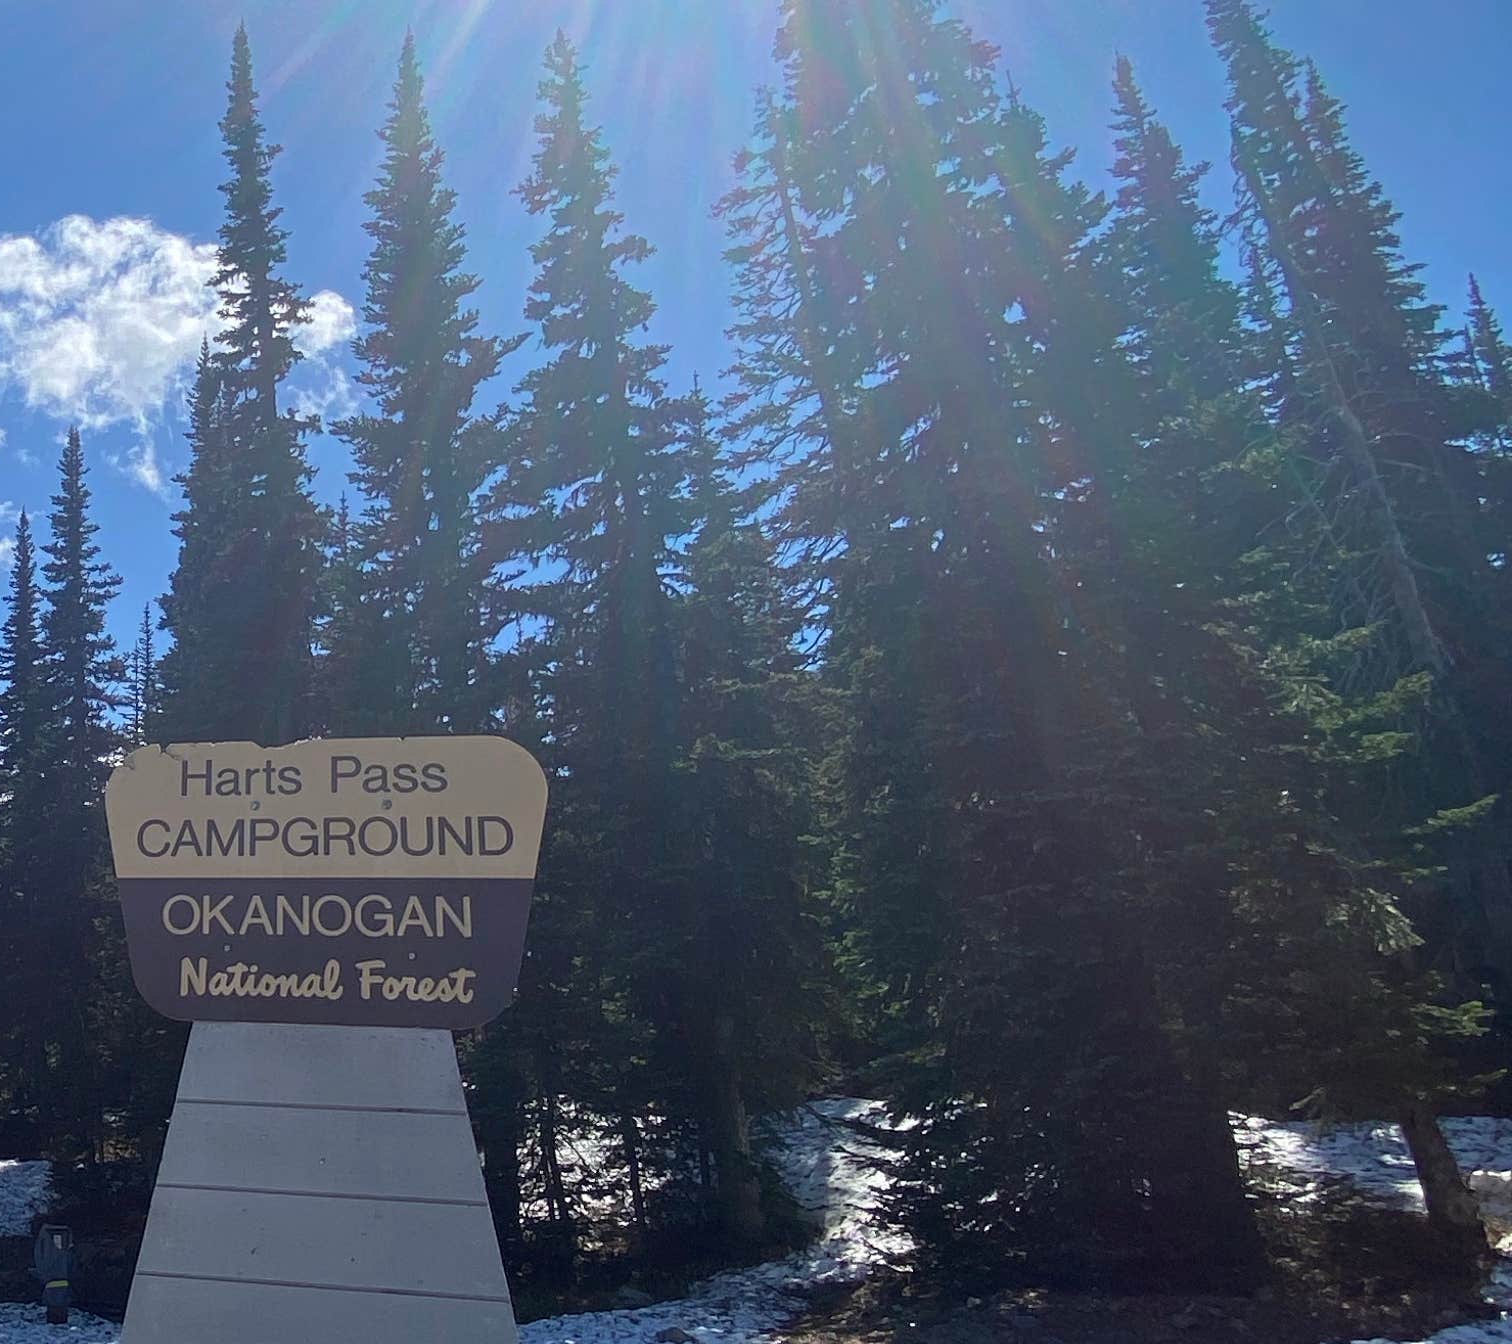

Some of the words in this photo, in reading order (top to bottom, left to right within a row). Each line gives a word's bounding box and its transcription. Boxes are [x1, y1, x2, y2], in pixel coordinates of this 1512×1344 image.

[180, 758, 303, 797] Harts
[330, 756, 449, 794] Pass
[136, 815, 515, 857] CAMPGROUND
[162, 893, 473, 939] OKANOGAN
[179, 957, 344, 1001] National
[355, 959, 477, 1005] Forest
